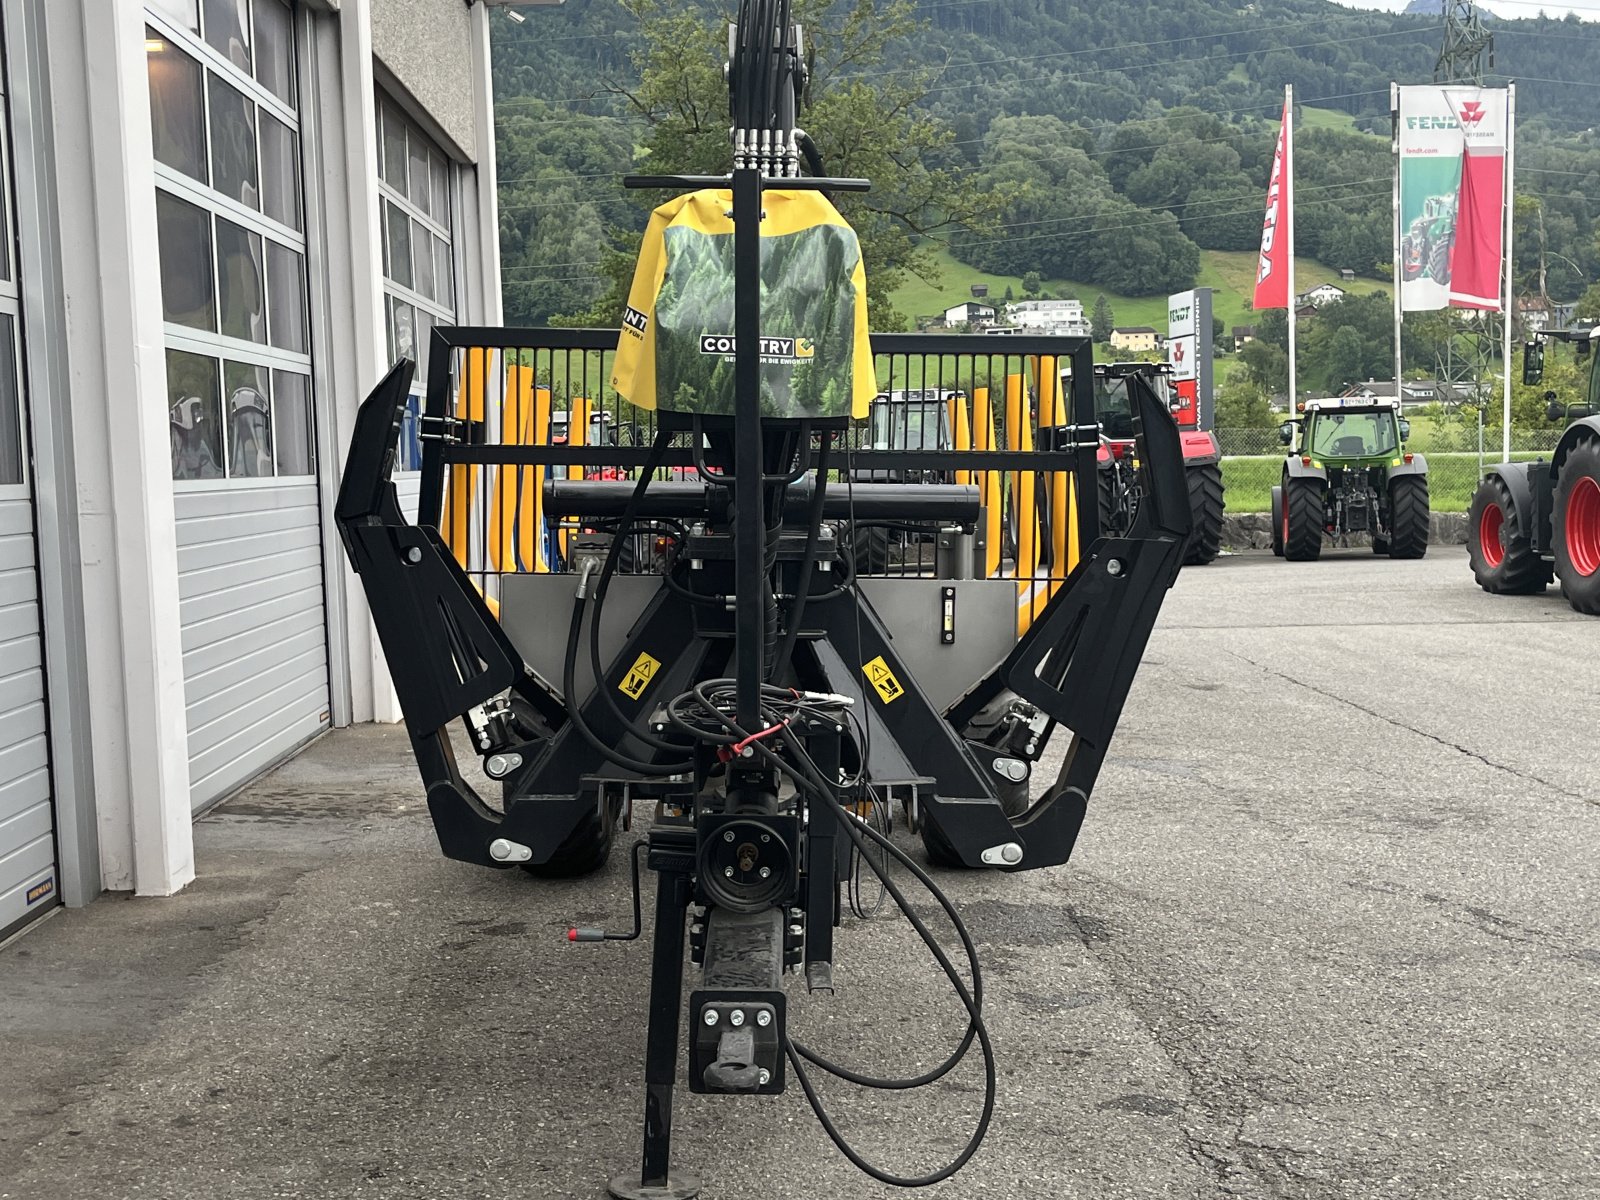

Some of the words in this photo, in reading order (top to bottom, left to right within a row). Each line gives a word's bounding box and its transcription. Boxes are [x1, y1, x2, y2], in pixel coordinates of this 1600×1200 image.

[1406, 116, 1460, 129] FEND
[1169, 305, 1190, 323] FENDT
[704, 338, 790, 354] COTRY
